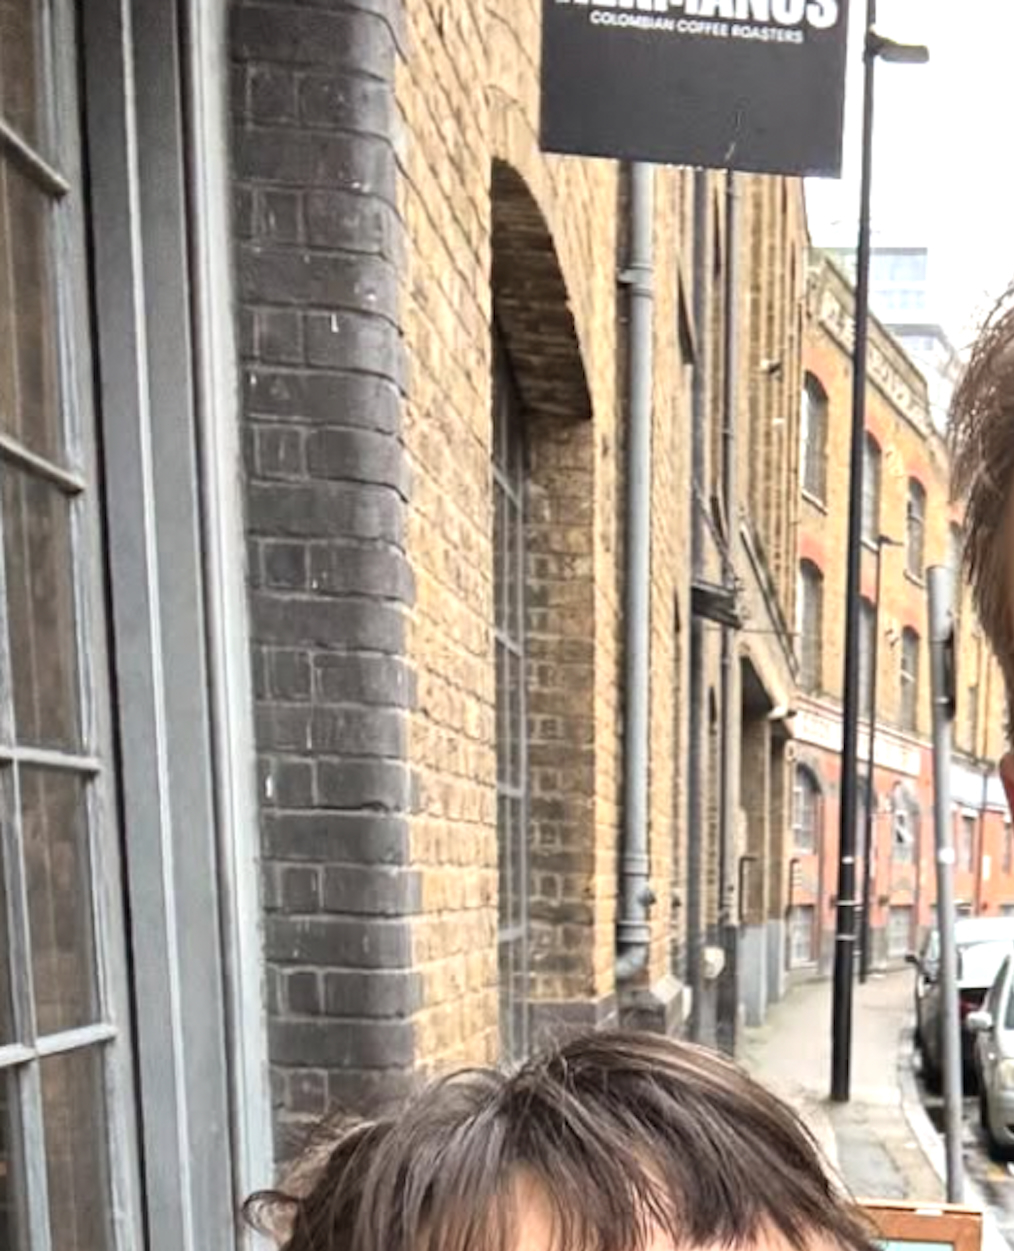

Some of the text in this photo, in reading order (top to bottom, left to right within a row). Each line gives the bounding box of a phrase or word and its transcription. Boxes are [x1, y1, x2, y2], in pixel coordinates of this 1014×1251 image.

[590, 10, 674, 31] COLOMBIAN
[677, 20, 728, 37] COFFEE
[730, 24, 803, 43] ROASTERS
